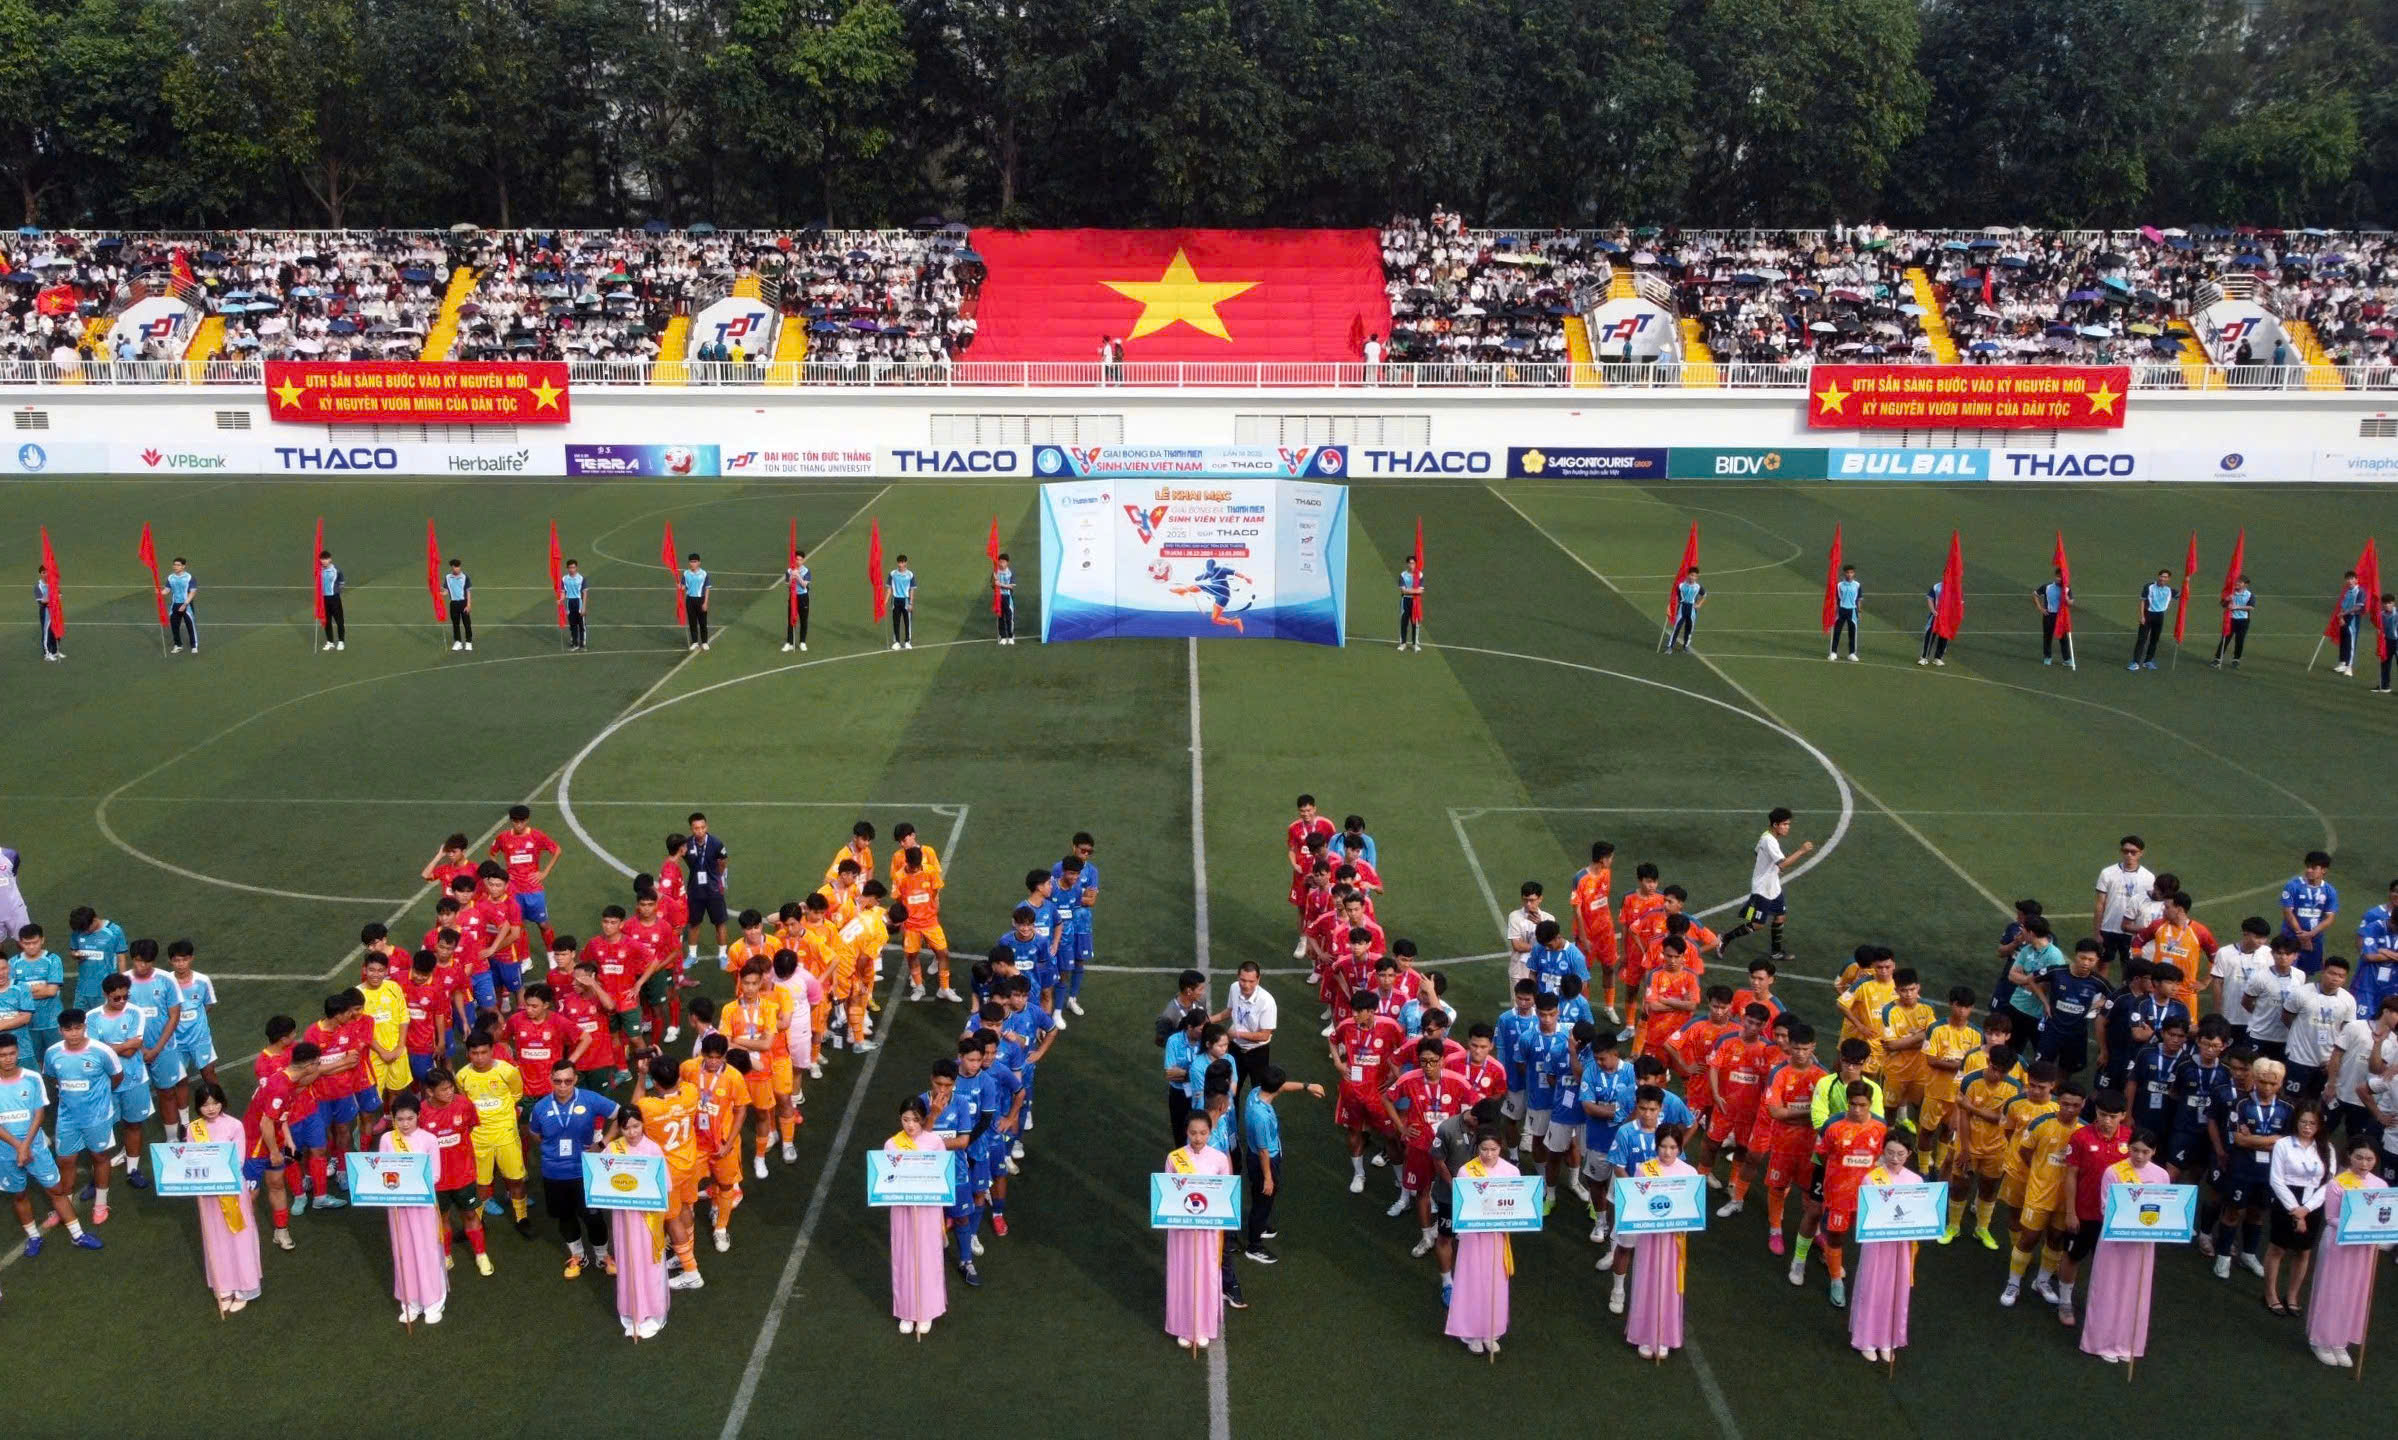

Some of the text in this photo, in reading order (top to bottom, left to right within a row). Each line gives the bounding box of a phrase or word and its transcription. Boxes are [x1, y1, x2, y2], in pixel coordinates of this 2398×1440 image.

[306, 374, 328, 388] UTH
[355, 371, 382, 388] SÀNG
[386, 371, 416, 388] BƯỚC
[419, 371, 441, 388] VÀO
[460, 371, 503, 388] NGUYÊN
[506, 372, 528, 388] MỚI
[1852, 379, 1876, 392] UTH
[1903, 375, 1933, 393] SÀNG
[1936, 375, 1968, 393] BƯỚC
[1972, 376, 1994, 393] VÀO
[2014, 376, 2059, 393] NGUYÊN
[2062, 376, 2086, 394] MỚI
[336, 394, 378, 411] NGUYÊN
[414, 394, 443, 411] MÌNH
[446, 394, 468, 411] CỦA
[472, 394, 494, 412] DÂN
[496, 395, 518, 413] TỘC
[1880, 399, 1924, 416] NGUYÊN
[1928, 400, 1958, 416] VƯƠN
[1962, 399, 1992, 416] MÌNH
[1996, 399, 2019, 417] CỦA
[2022, 399, 2044, 417] DÂN
[2048, 400, 2070, 419] TỘC
[166, 454, 226, 469] VPBank
[274, 447, 398, 470] THACO
[449, 453, 524, 472] Herbalife
[802, 450, 818, 462] TÔN
[891, 450, 1017, 473] THACO
[1364, 450, 1491, 473] THACO
[1548, 456, 1635, 468] SAIGONTOURIST
[574, 458, 640, 470] TERRA
[764, 464, 872, 473] TON DUC THANG UNIVERSITY
[1096, 460, 1203, 472] SINH VIÊN VIỆT NAM
[1231, 461, 1273, 469] THACO
[1715, 456, 1766, 474] BIDV
[1840, 453, 1978, 475] BULBAL
[2006, 454, 2135, 477] THACO
[1172, 490, 1202, 501] KHAI
[1216, 529, 1259, 537] THACO
[2058, 1003, 2084, 1013] THACO
[1732, 1073, 1757, 1083] THACO
[60, 1082, 88, 1091] THACO
[2286, 1080, 2301, 1093] 20
[0, 1110, 28, 1121] THACO
[663, 1116, 691, 1152] 21
[1846, 1157, 1871, 1166] THACO
[184, 1166, 210, 1179] STU
[2233, 1189, 2243, 1202] 3
[1497, 1198, 1515, 1207] SIU
[1650, 1201, 1670, 1210] SGU
